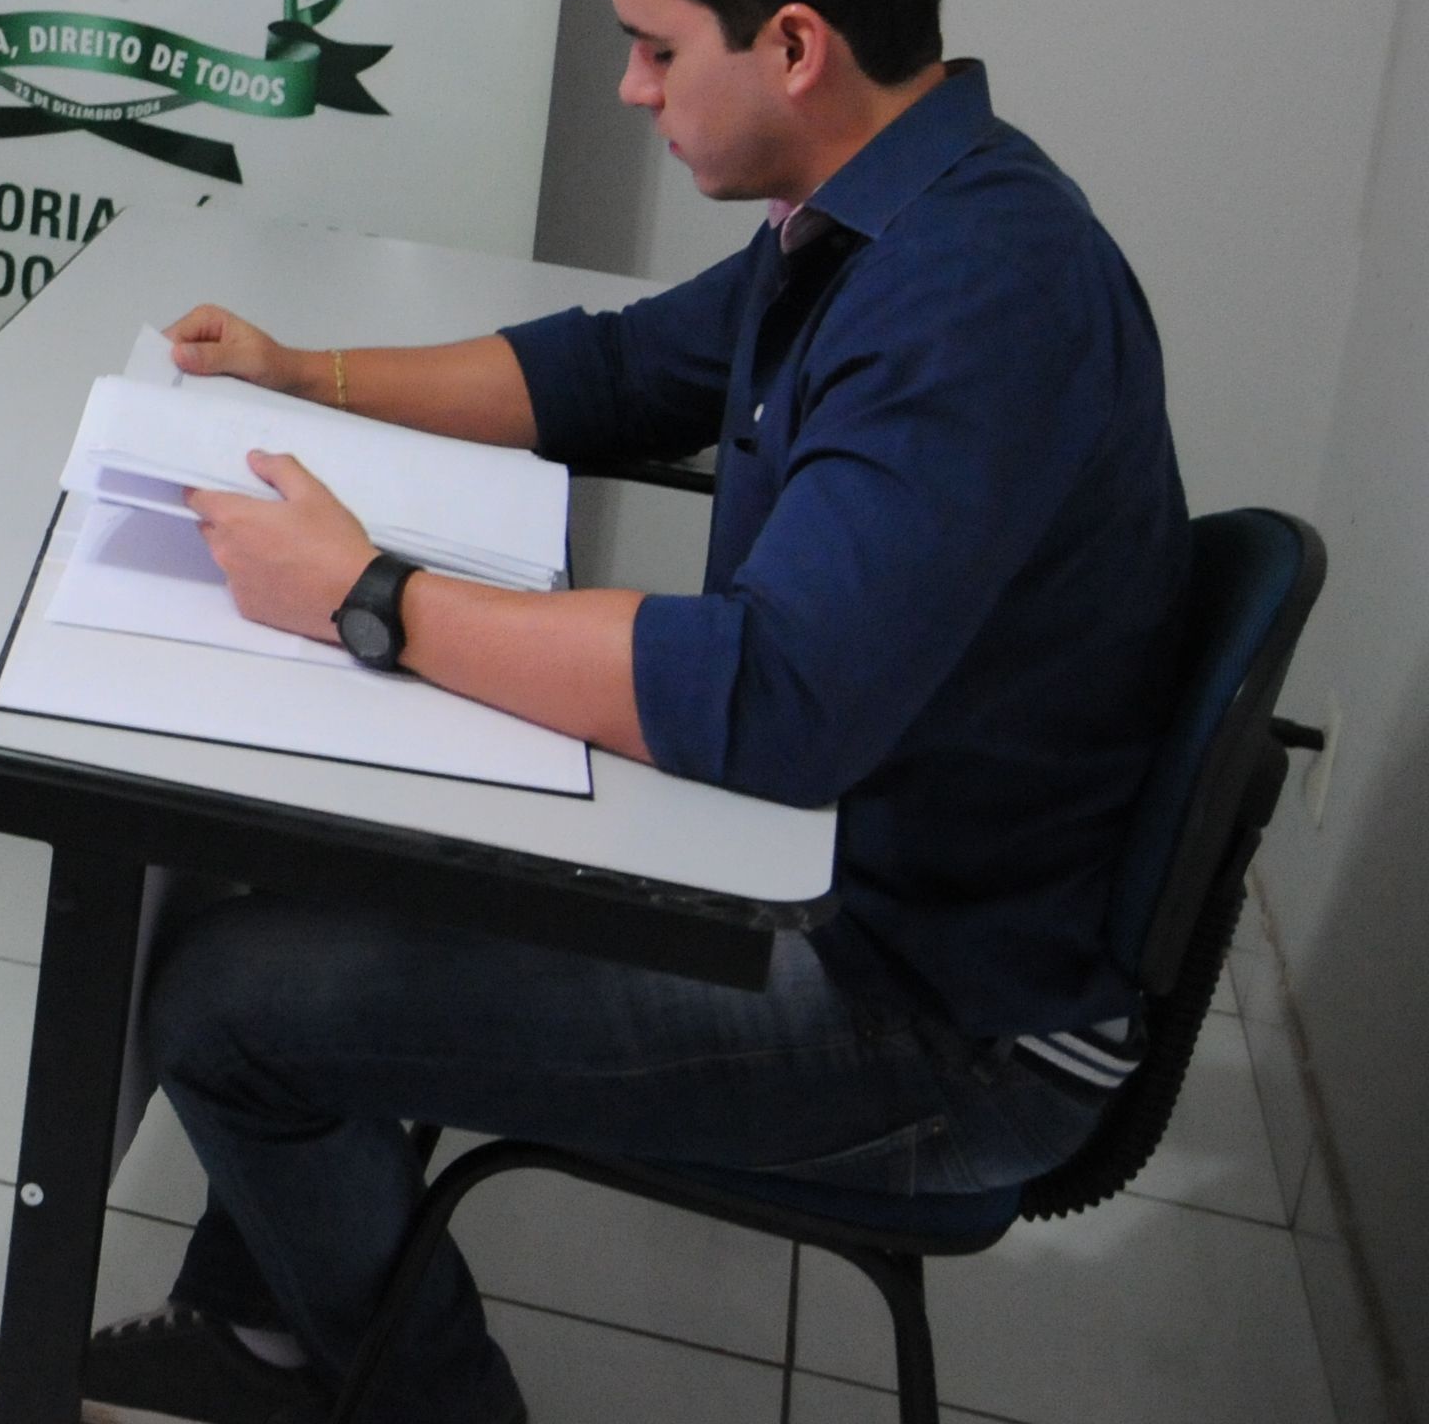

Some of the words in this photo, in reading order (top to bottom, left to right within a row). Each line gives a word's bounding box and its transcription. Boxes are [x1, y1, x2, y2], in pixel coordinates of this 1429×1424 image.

[29, 25, 141, 65] DIREITO
[150, 43, 188, 78] DE
[196, 57, 286, 106] TODOS
[14, 81, 31, 101] 22
[33, 91, 49, 109] DE
[52, 99, 123, 121] DEZEMBRO
